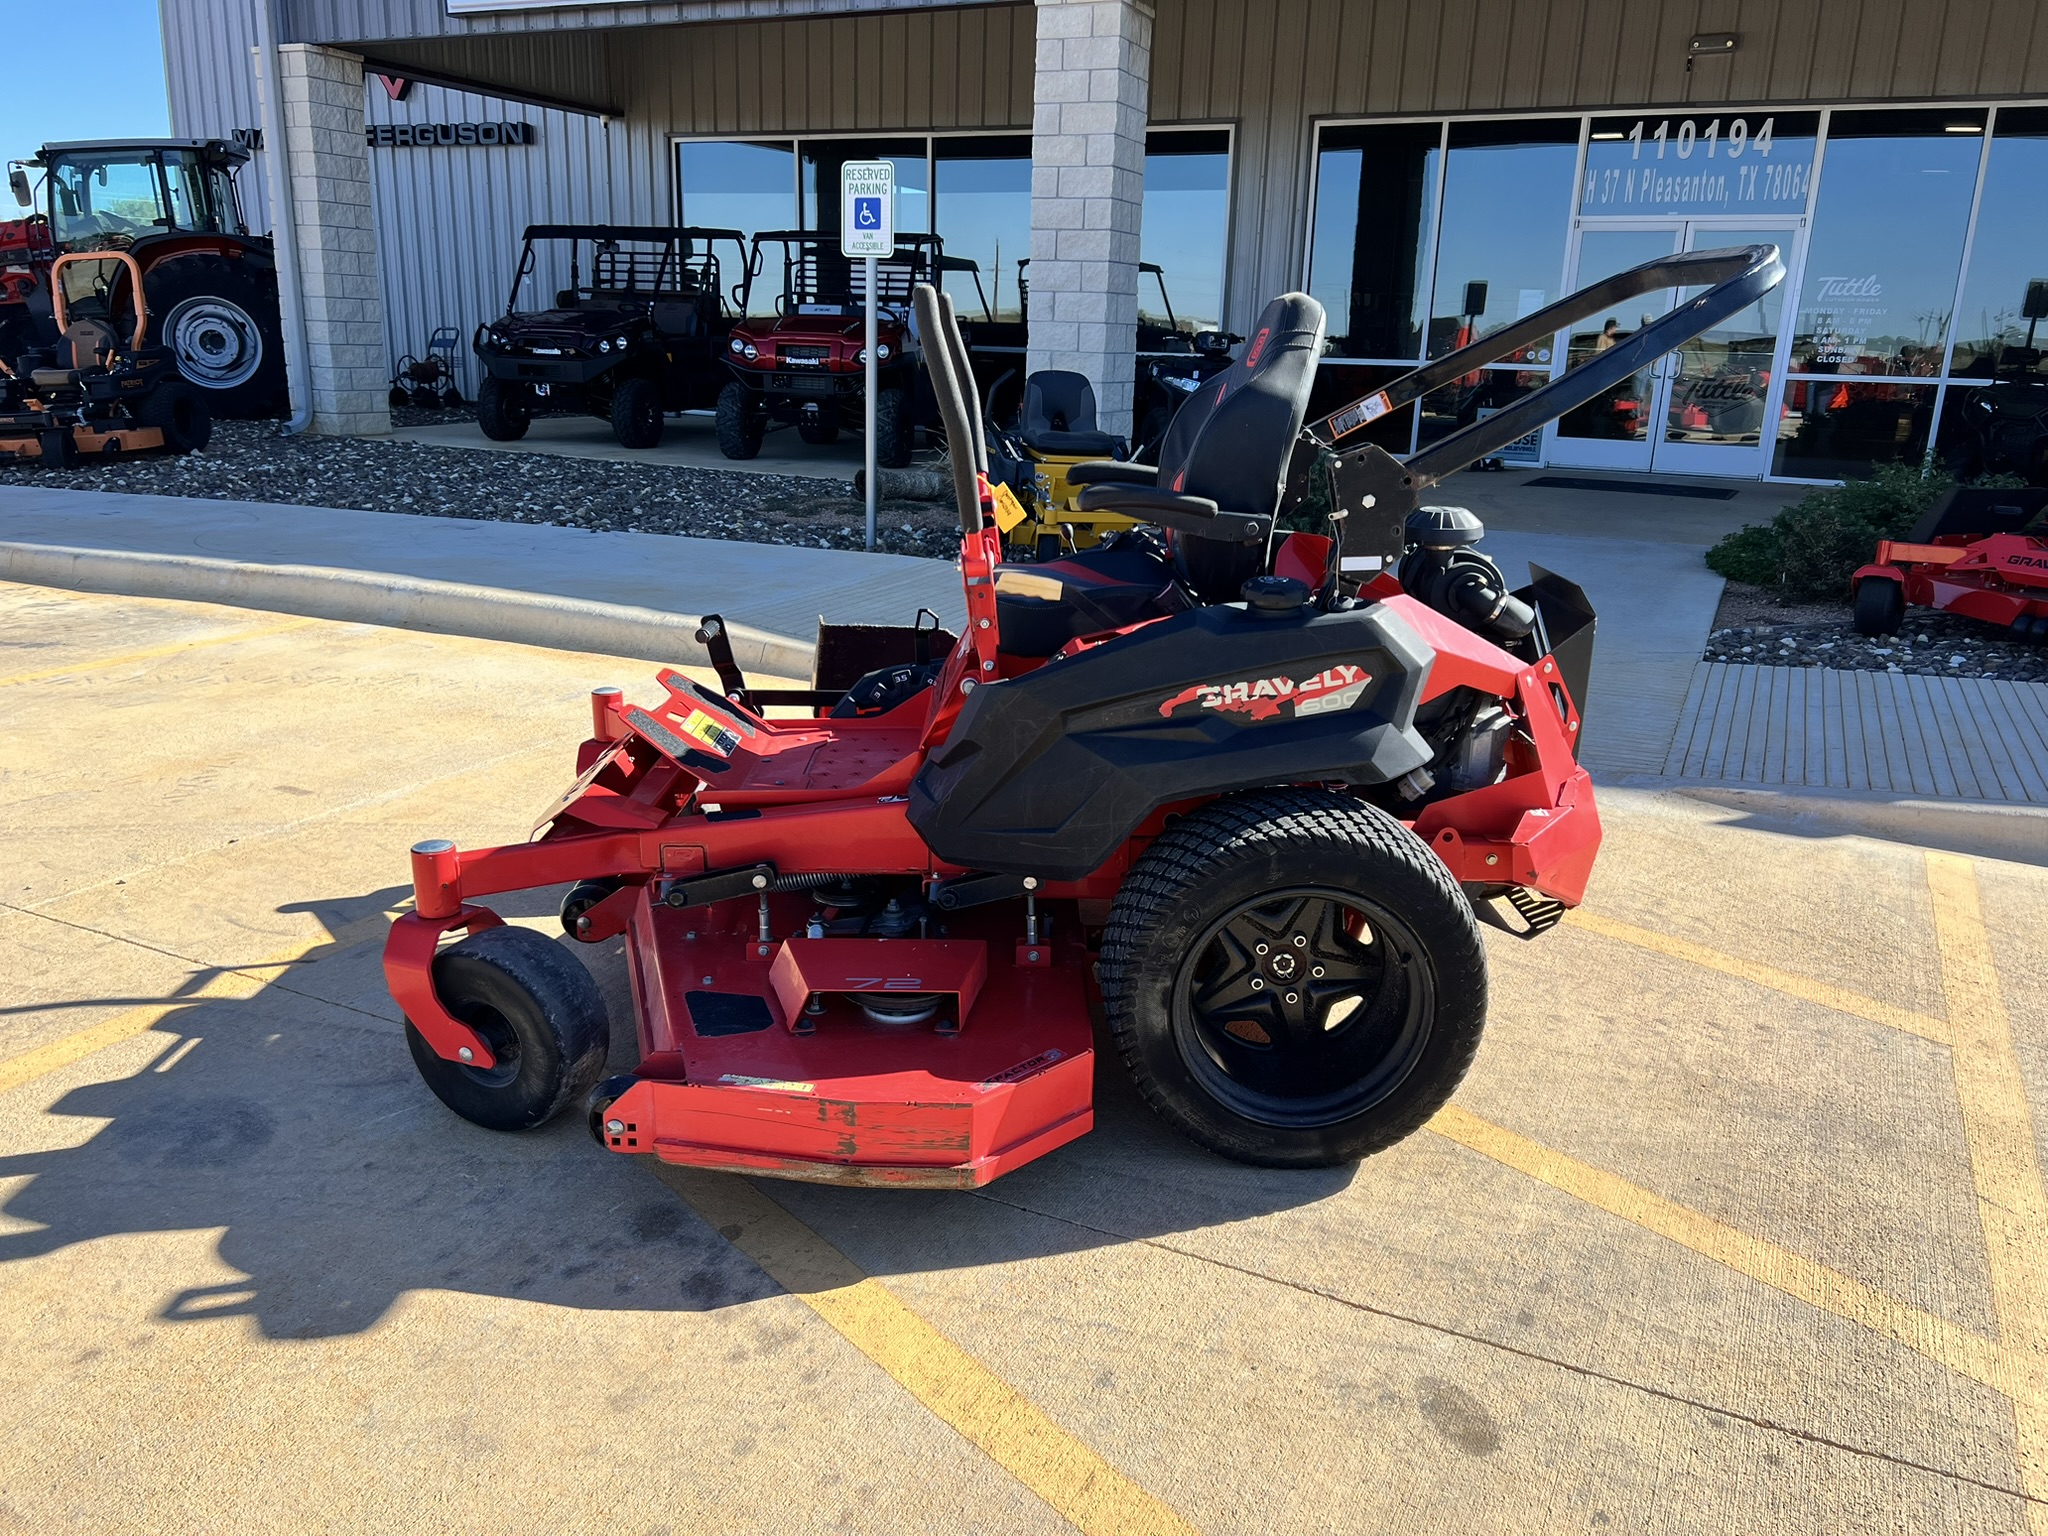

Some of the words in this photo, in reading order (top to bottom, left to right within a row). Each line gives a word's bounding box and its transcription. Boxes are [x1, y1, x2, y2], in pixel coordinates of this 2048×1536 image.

[1628, 117, 1775, 160] 110194
[845, 168, 890, 181] RESERVED
[848, 182, 888, 195] PARKING
[1602, 168, 1620, 204] 37
[1624, 168, 1636, 204] N
[1640, 167, 1729, 209] Pleasanton,
[1738, 165, 1759, 201] TX
[1763, 163, 1812, 201] 78064
[862, 232, 874, 240] VAN
[852, 242, 884, 250] ACCESSIBLE
[1817, 274, 1882, 302] Tuttle
[1805, 307, 1846, 315] MONDAY
[1853, 307, 1889, 316] FRIDAY
[1816, 326, 1867, 335] SATURDAY
[1852, 337, 1867, 345] PM
[785, 356, 819, 366] Kawasaki
[1816, 355, 1855, 363] CLOSED
[1682, 377, 1757, 406] Tuttle
[845, 977, 922, 989] 72
